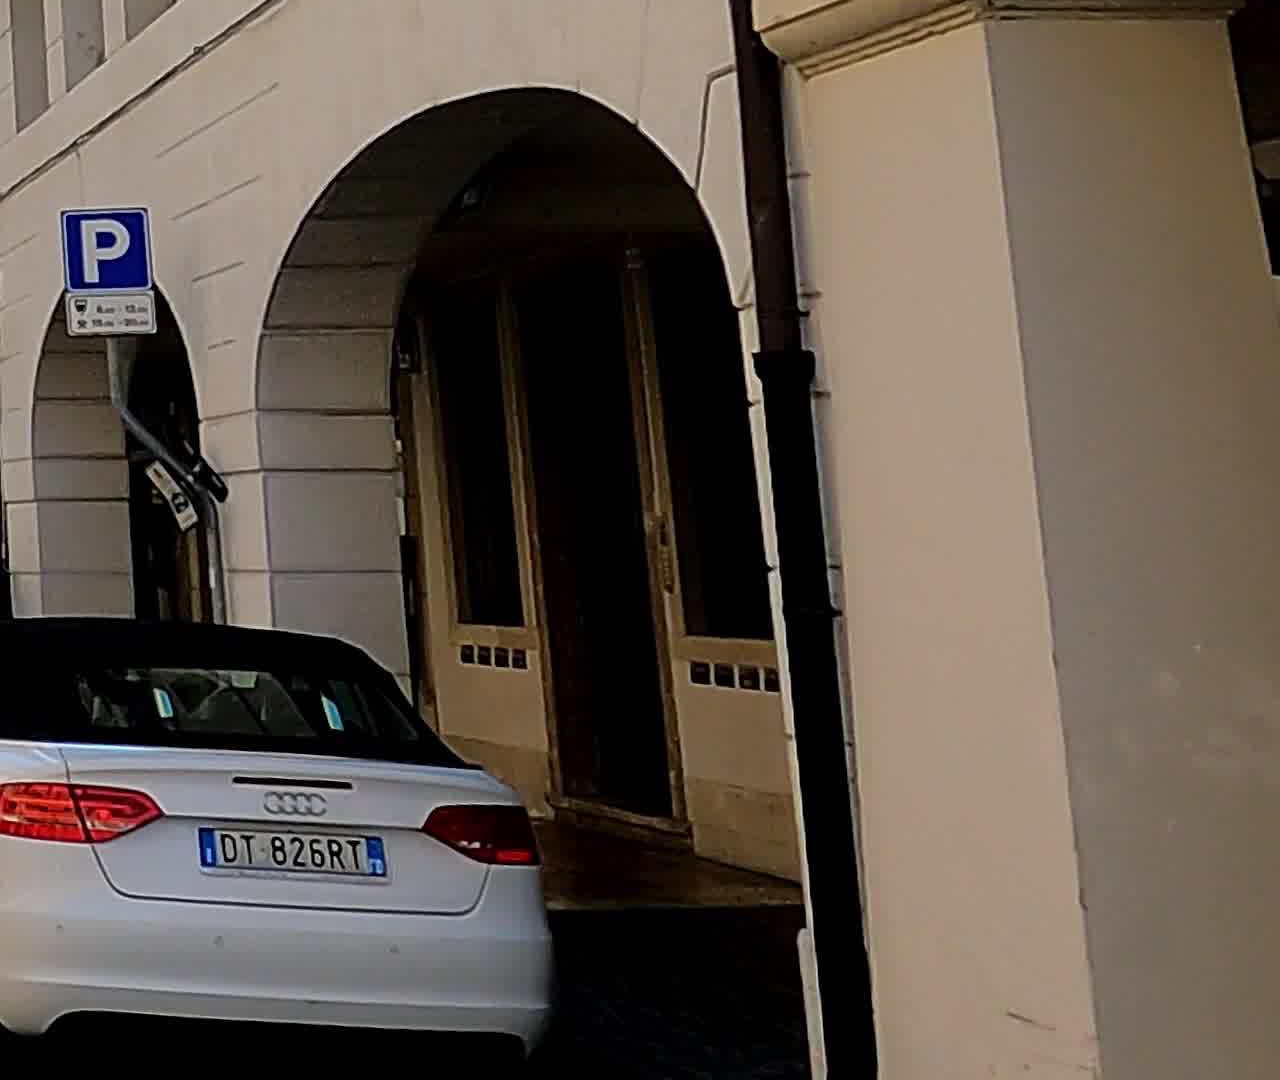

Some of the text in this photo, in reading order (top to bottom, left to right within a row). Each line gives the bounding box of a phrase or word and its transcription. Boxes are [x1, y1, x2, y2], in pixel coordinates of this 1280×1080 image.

[80, 219, 131, 284] P
[220, 833, 255, 864] DT
[270, 836, 361, 870] 826RT
